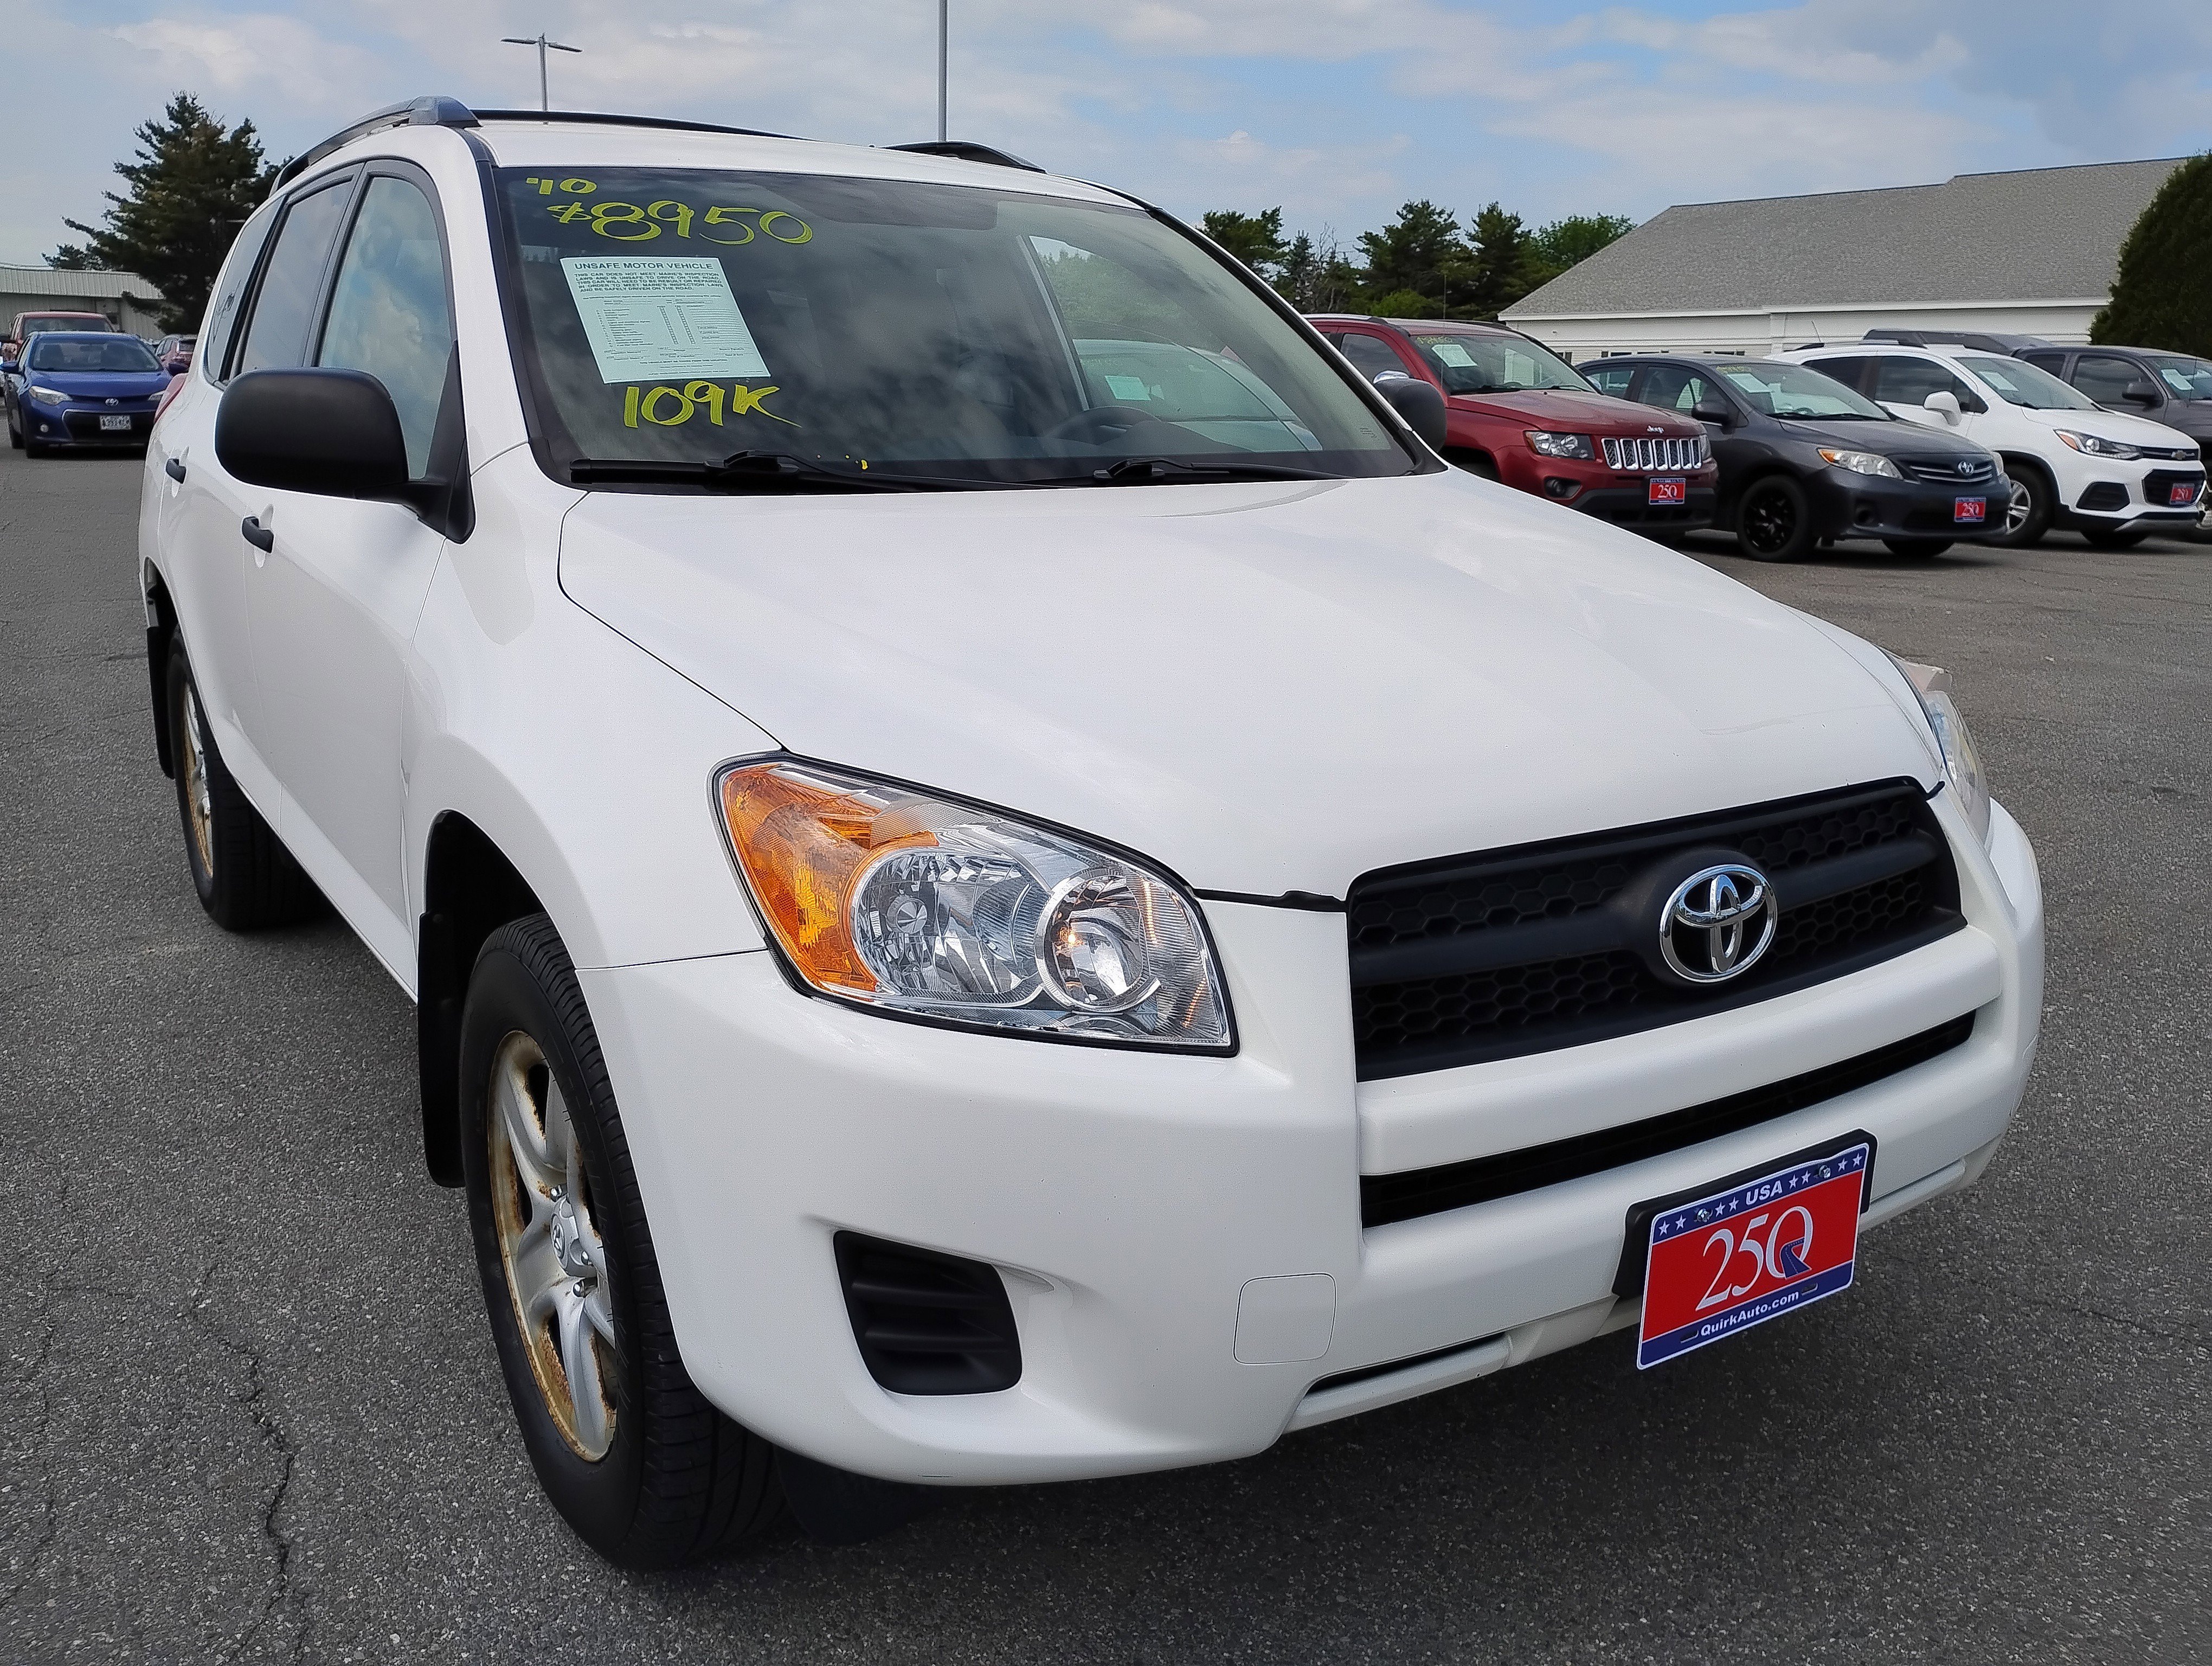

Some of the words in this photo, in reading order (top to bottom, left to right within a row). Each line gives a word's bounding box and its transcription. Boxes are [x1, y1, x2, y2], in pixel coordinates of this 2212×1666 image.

[546, 200, 813, 245] $8950
[623, 380, 802, 428] 109K
[1745, 1181, 1783, 1206] USA
[1701, 1290, 1799, 1337] QuirkAuto.com
